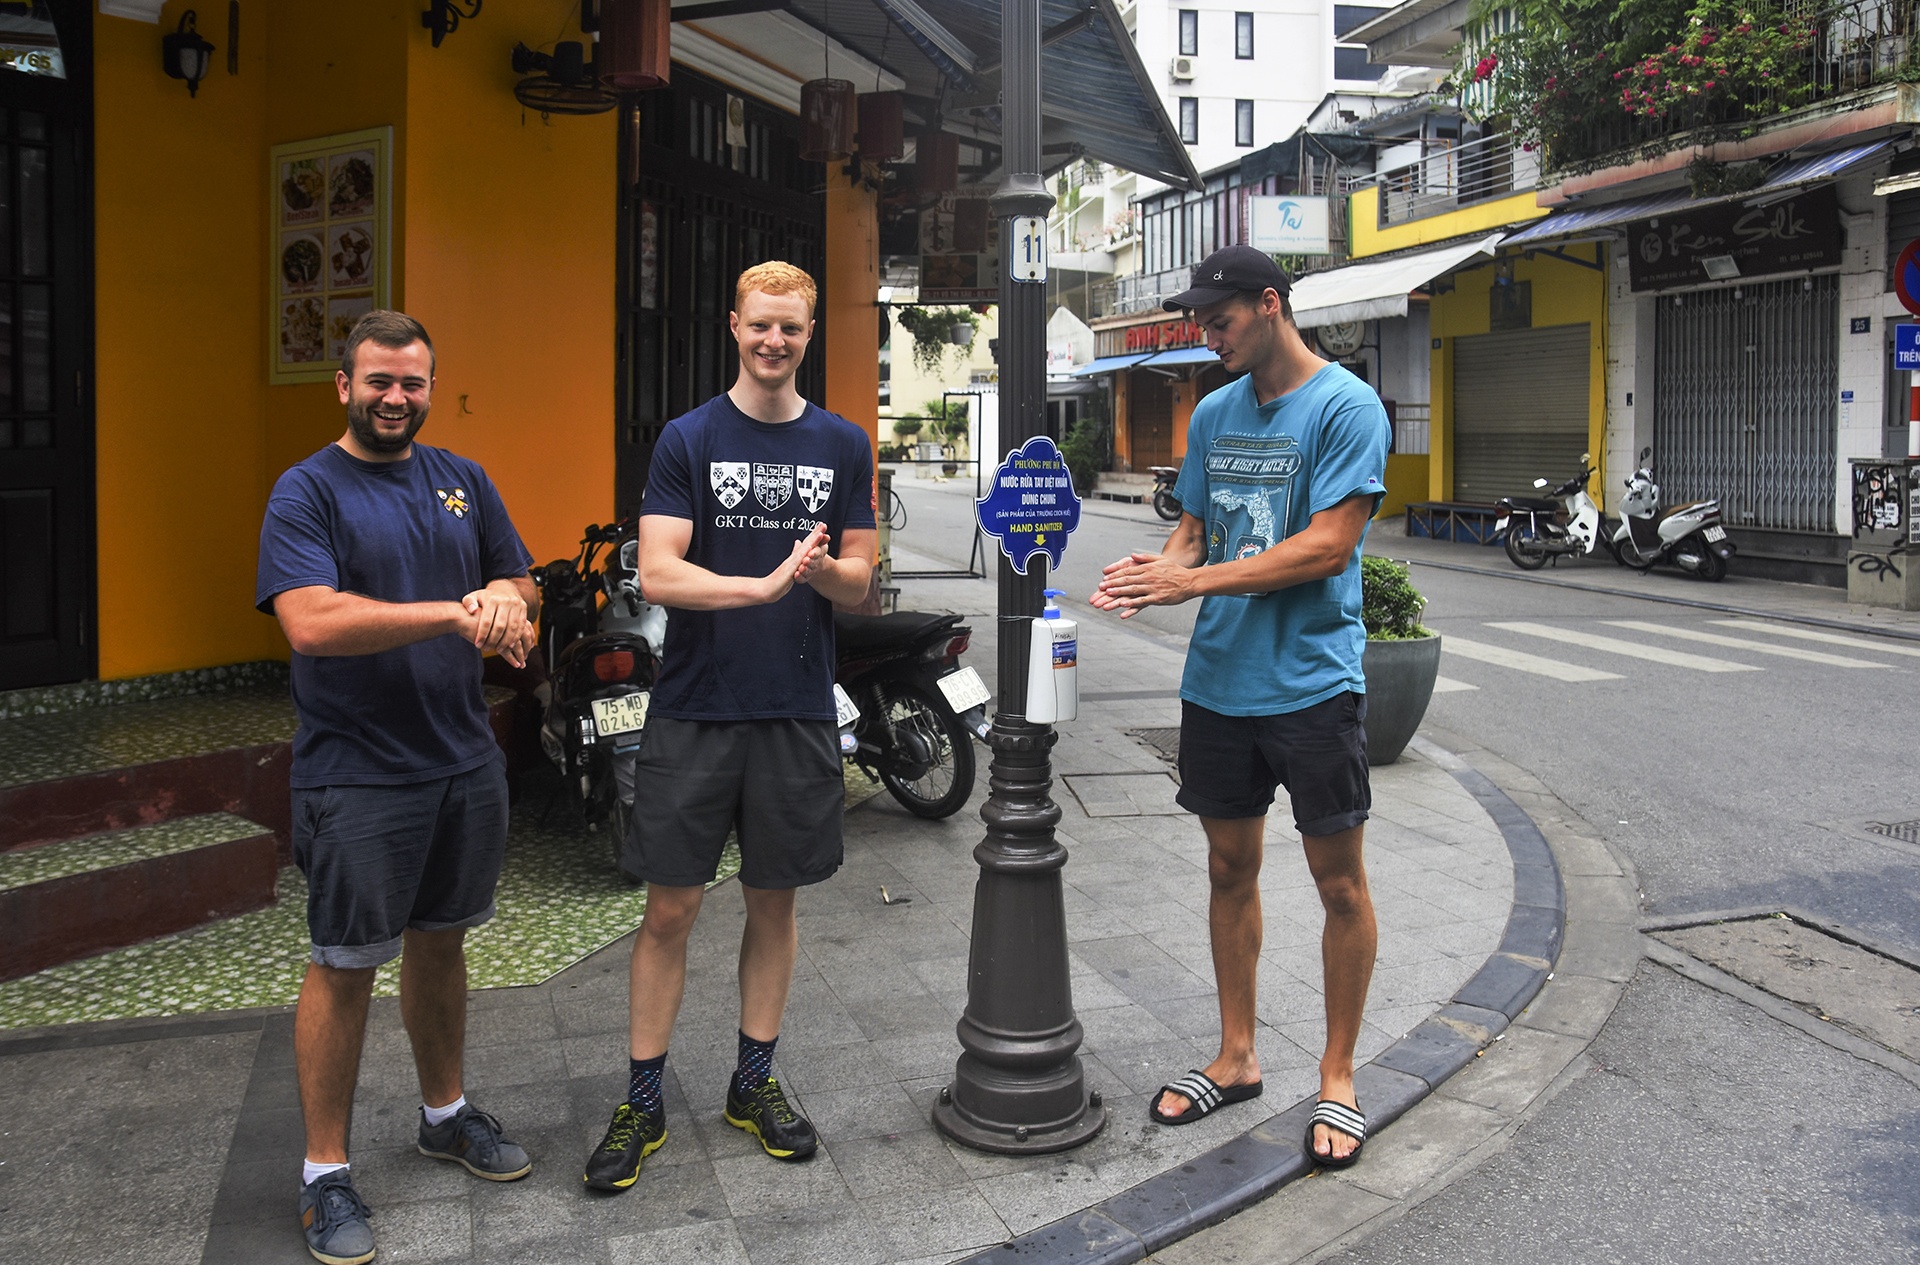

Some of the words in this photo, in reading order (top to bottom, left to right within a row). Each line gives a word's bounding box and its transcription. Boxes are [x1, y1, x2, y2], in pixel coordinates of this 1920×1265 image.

[1668, 224, 1725, 256] Ken
[1732, 202, 1816, 245] Silk
[1024, 234, 1041, 263] 11
[1855, 320, 1865, 331] 25
[1126, 325, 1159, 348] ANH
[1229, 457, 1263, 473] NIGHT
[1000, 474, 1019, 488] NƯỚC
[1020, 473, 1033, 488] RỬA
[1034, 477, 1044, 488] TAY
[1021, 492, 1038, 505] DÙNG
[1040, 493, 1056, 505] CHUNG
[715, 515, 748, 529] GKT
[749, 515, 780, 529] Class
[782, 517, 796, 530] of
[1010, 523, 1033, 533] HAND
[1035, 522, 1063, 532] SANITIZER
